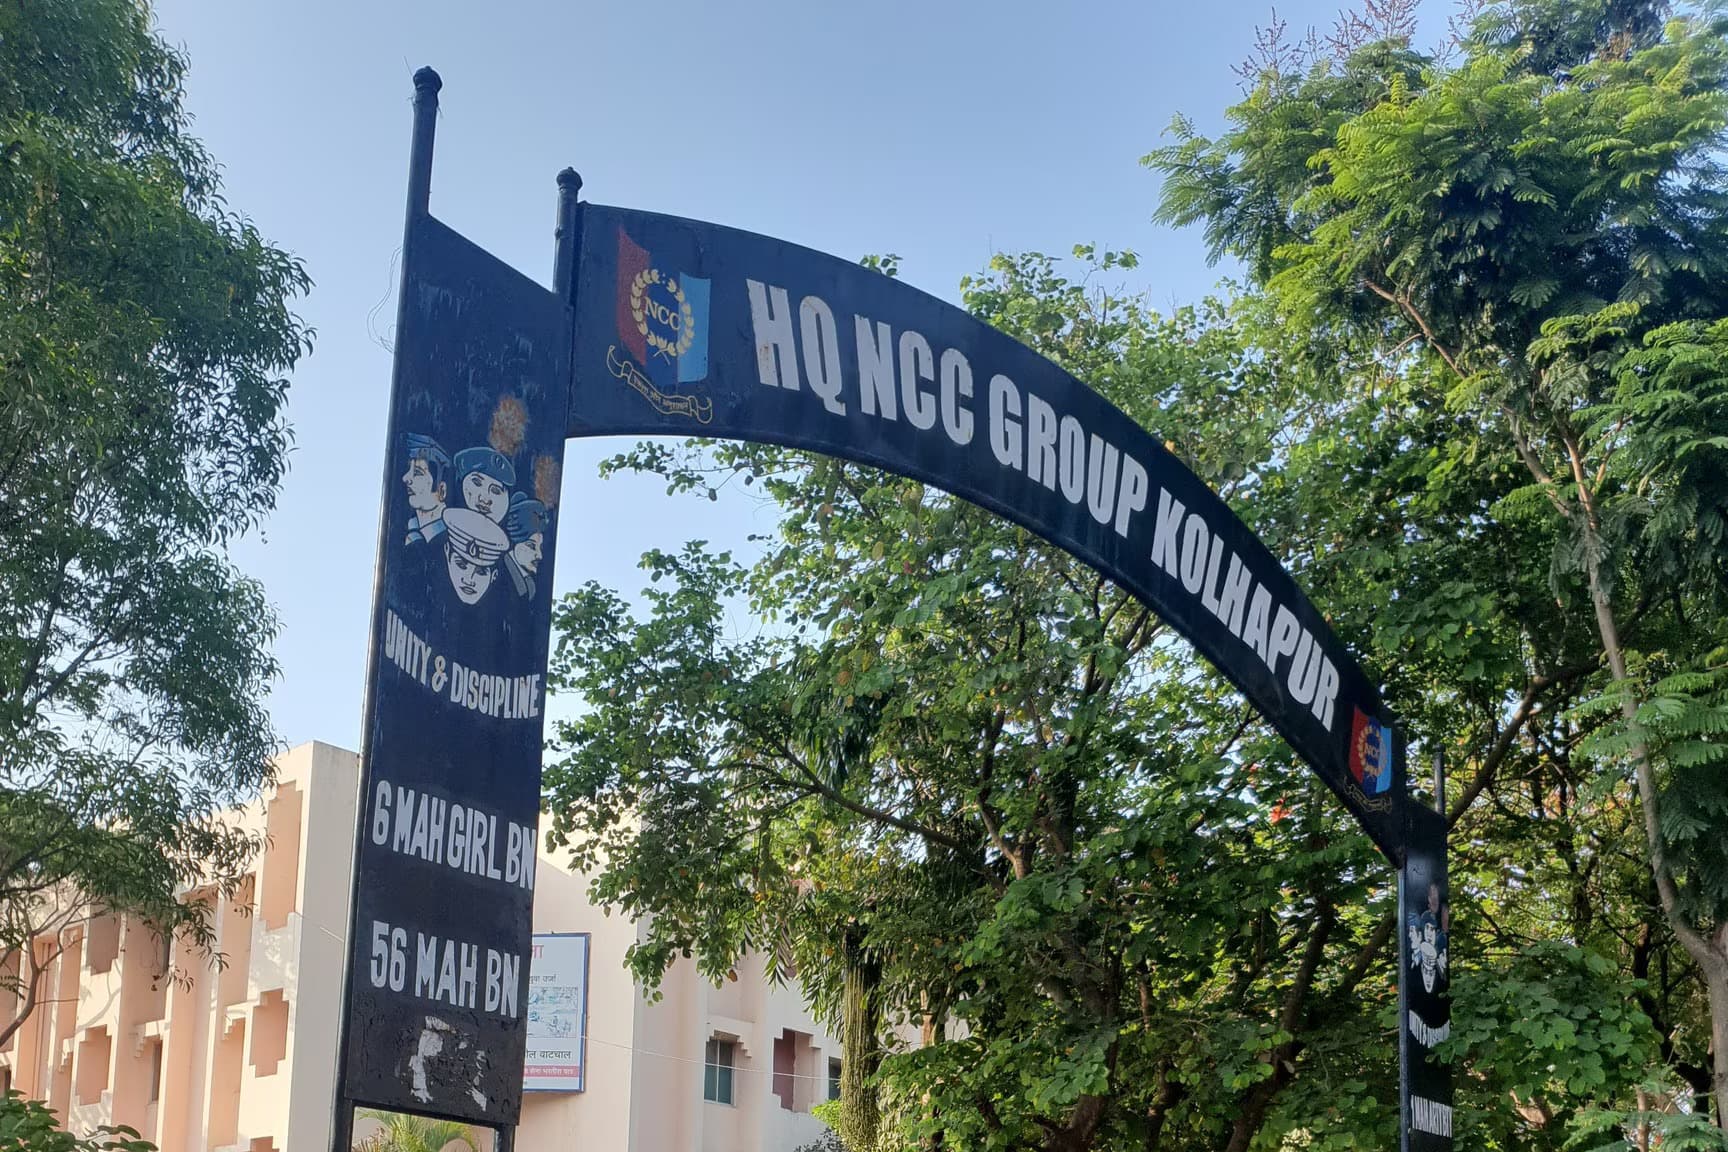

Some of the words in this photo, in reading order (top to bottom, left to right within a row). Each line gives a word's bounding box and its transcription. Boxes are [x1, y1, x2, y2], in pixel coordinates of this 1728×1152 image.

[644, 297, 681, 331] NCC
[746, 278, 847, 417] HQ
[854, 313, 975, 446] NCC
[989, 373, 1149, 539] GROUP
[1150, 486, 1341, 733] KOLHAPUR
[385, 608, 432, 686] UNITY
[431, 655, 448, 693] &
[450, 661, 540, 719] DISCIPLINE
[372, 780, 392, 845] 6
[392, 786, 446, 864] MAH
[447, 804, 501, 880] GIRL
[505, 822, 537, 890] BN
[370, 920, 407, 992] 56
[414, 932, 478, 1009] MAH
[484, 948, 520, 1018] BN
